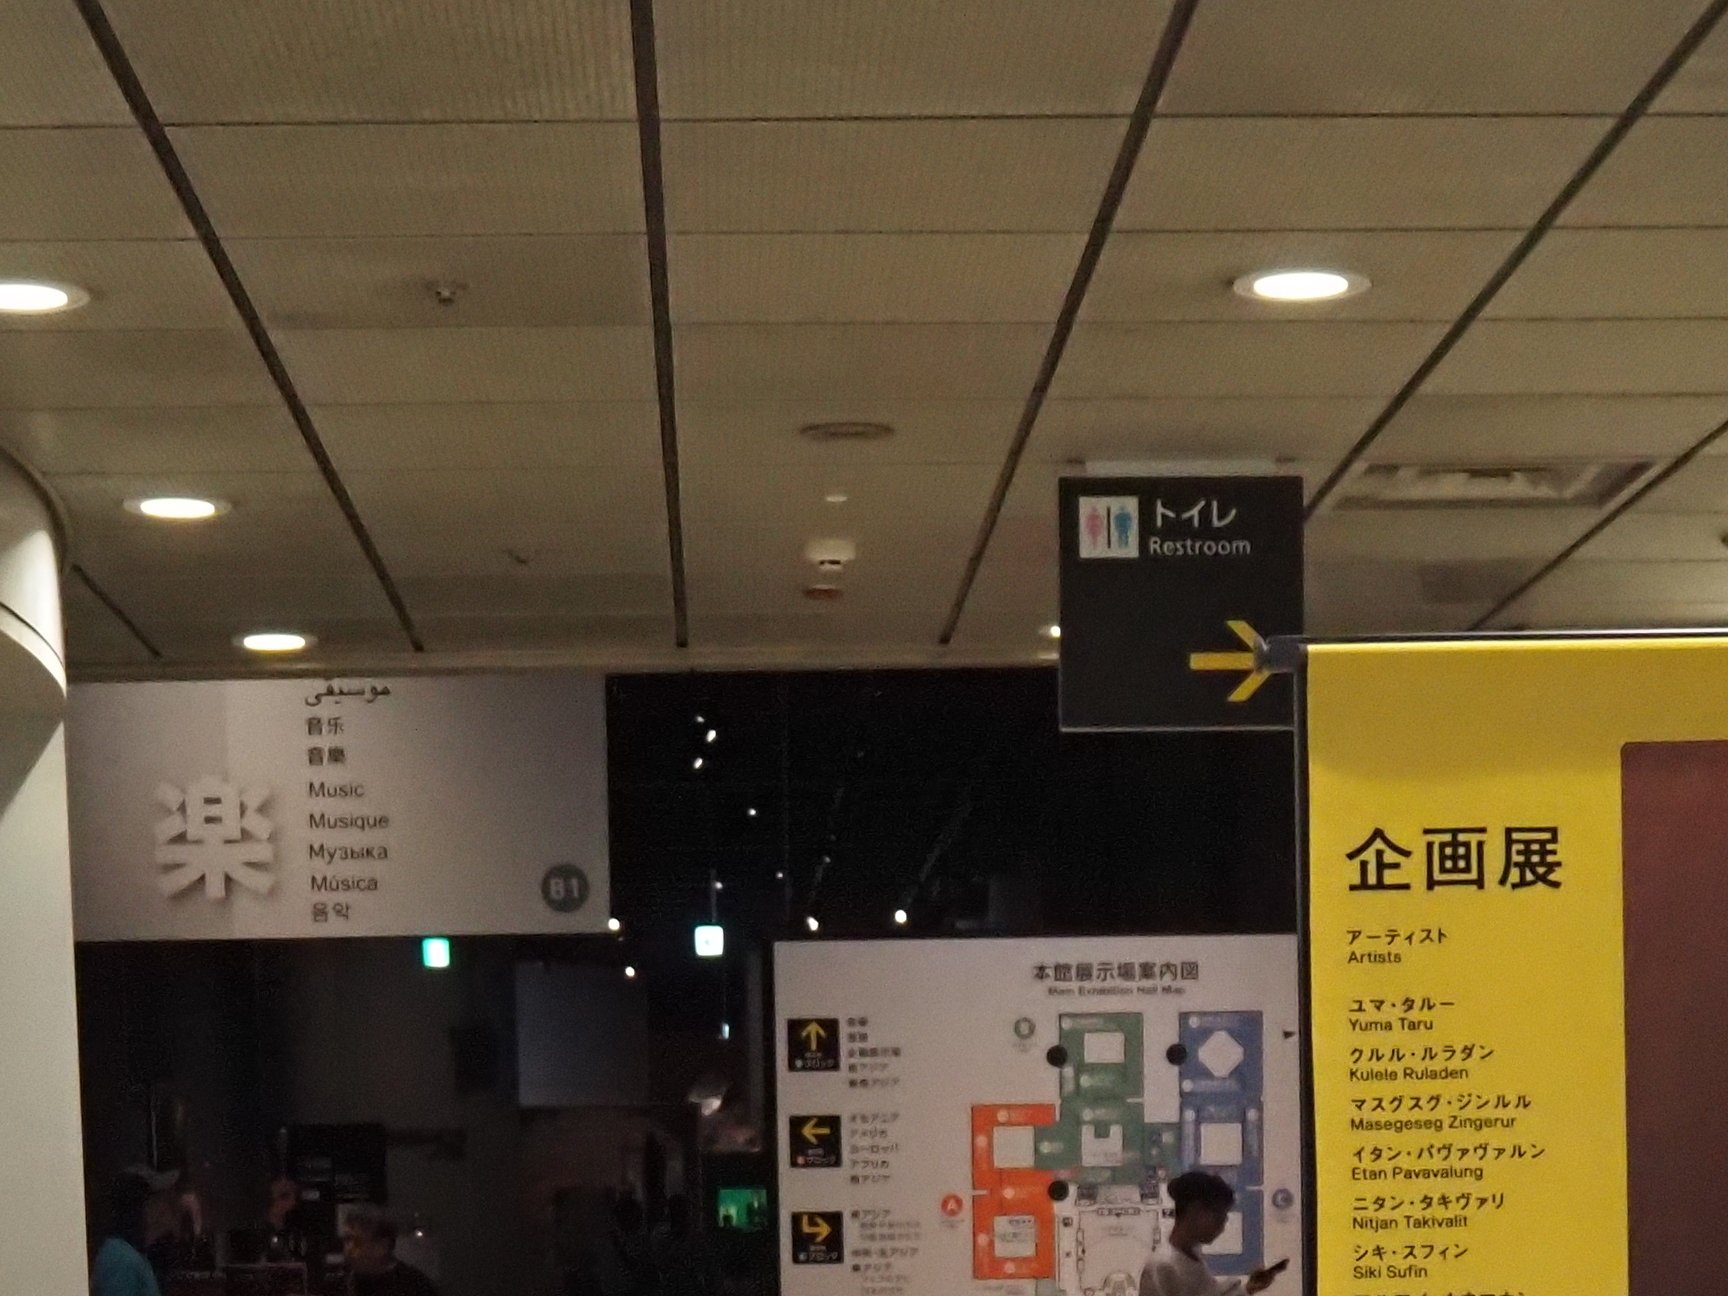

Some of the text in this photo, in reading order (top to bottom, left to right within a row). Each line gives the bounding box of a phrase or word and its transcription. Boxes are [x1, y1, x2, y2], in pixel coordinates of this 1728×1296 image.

[1156, 499, 1238, 528] トイレ
[1149, 536, 1251, 555] Restroom
[308, 782, 365, 799] Music
[308, 812, 390, 833] Musique
[154, 772, 272, 900] 楽
[308, 843, 389, 864] Музыка
[1345, 826, 1564, 893] 企画展
[310, 872, 379, 892] Música
[311, 902, 351, 923] 음악
[1346, 928, 1449, 946] アーティスト
[1347, 951, 1402, 965] Artists
[1349, 997, 1456, 1014] ユマ・タルー
[1348, 1017, 1434, 1033] Yuma Taru
[1349, 1045, 1495, 1063] クルル・ルラダン
[1349, 1066, 1469, 1082] Kulele Ruladen
[1350, 1094, 1532, 1112] マスグスグ・ジンルル
[1350, 1115, 1517, 1134] Masegeseg Zingerur
[1351, 1165, 1484, 1181] Etan Pavavalung
[1352, 1192, 1506, 1212] ニタン・タキヴァリ
[1352, 1215, 1399, 1232] Nitjan
[1353, 1244, 1469, 1262] シキ・スフィン
[1352, 1264, 1428, 1279] Siki Sufin
